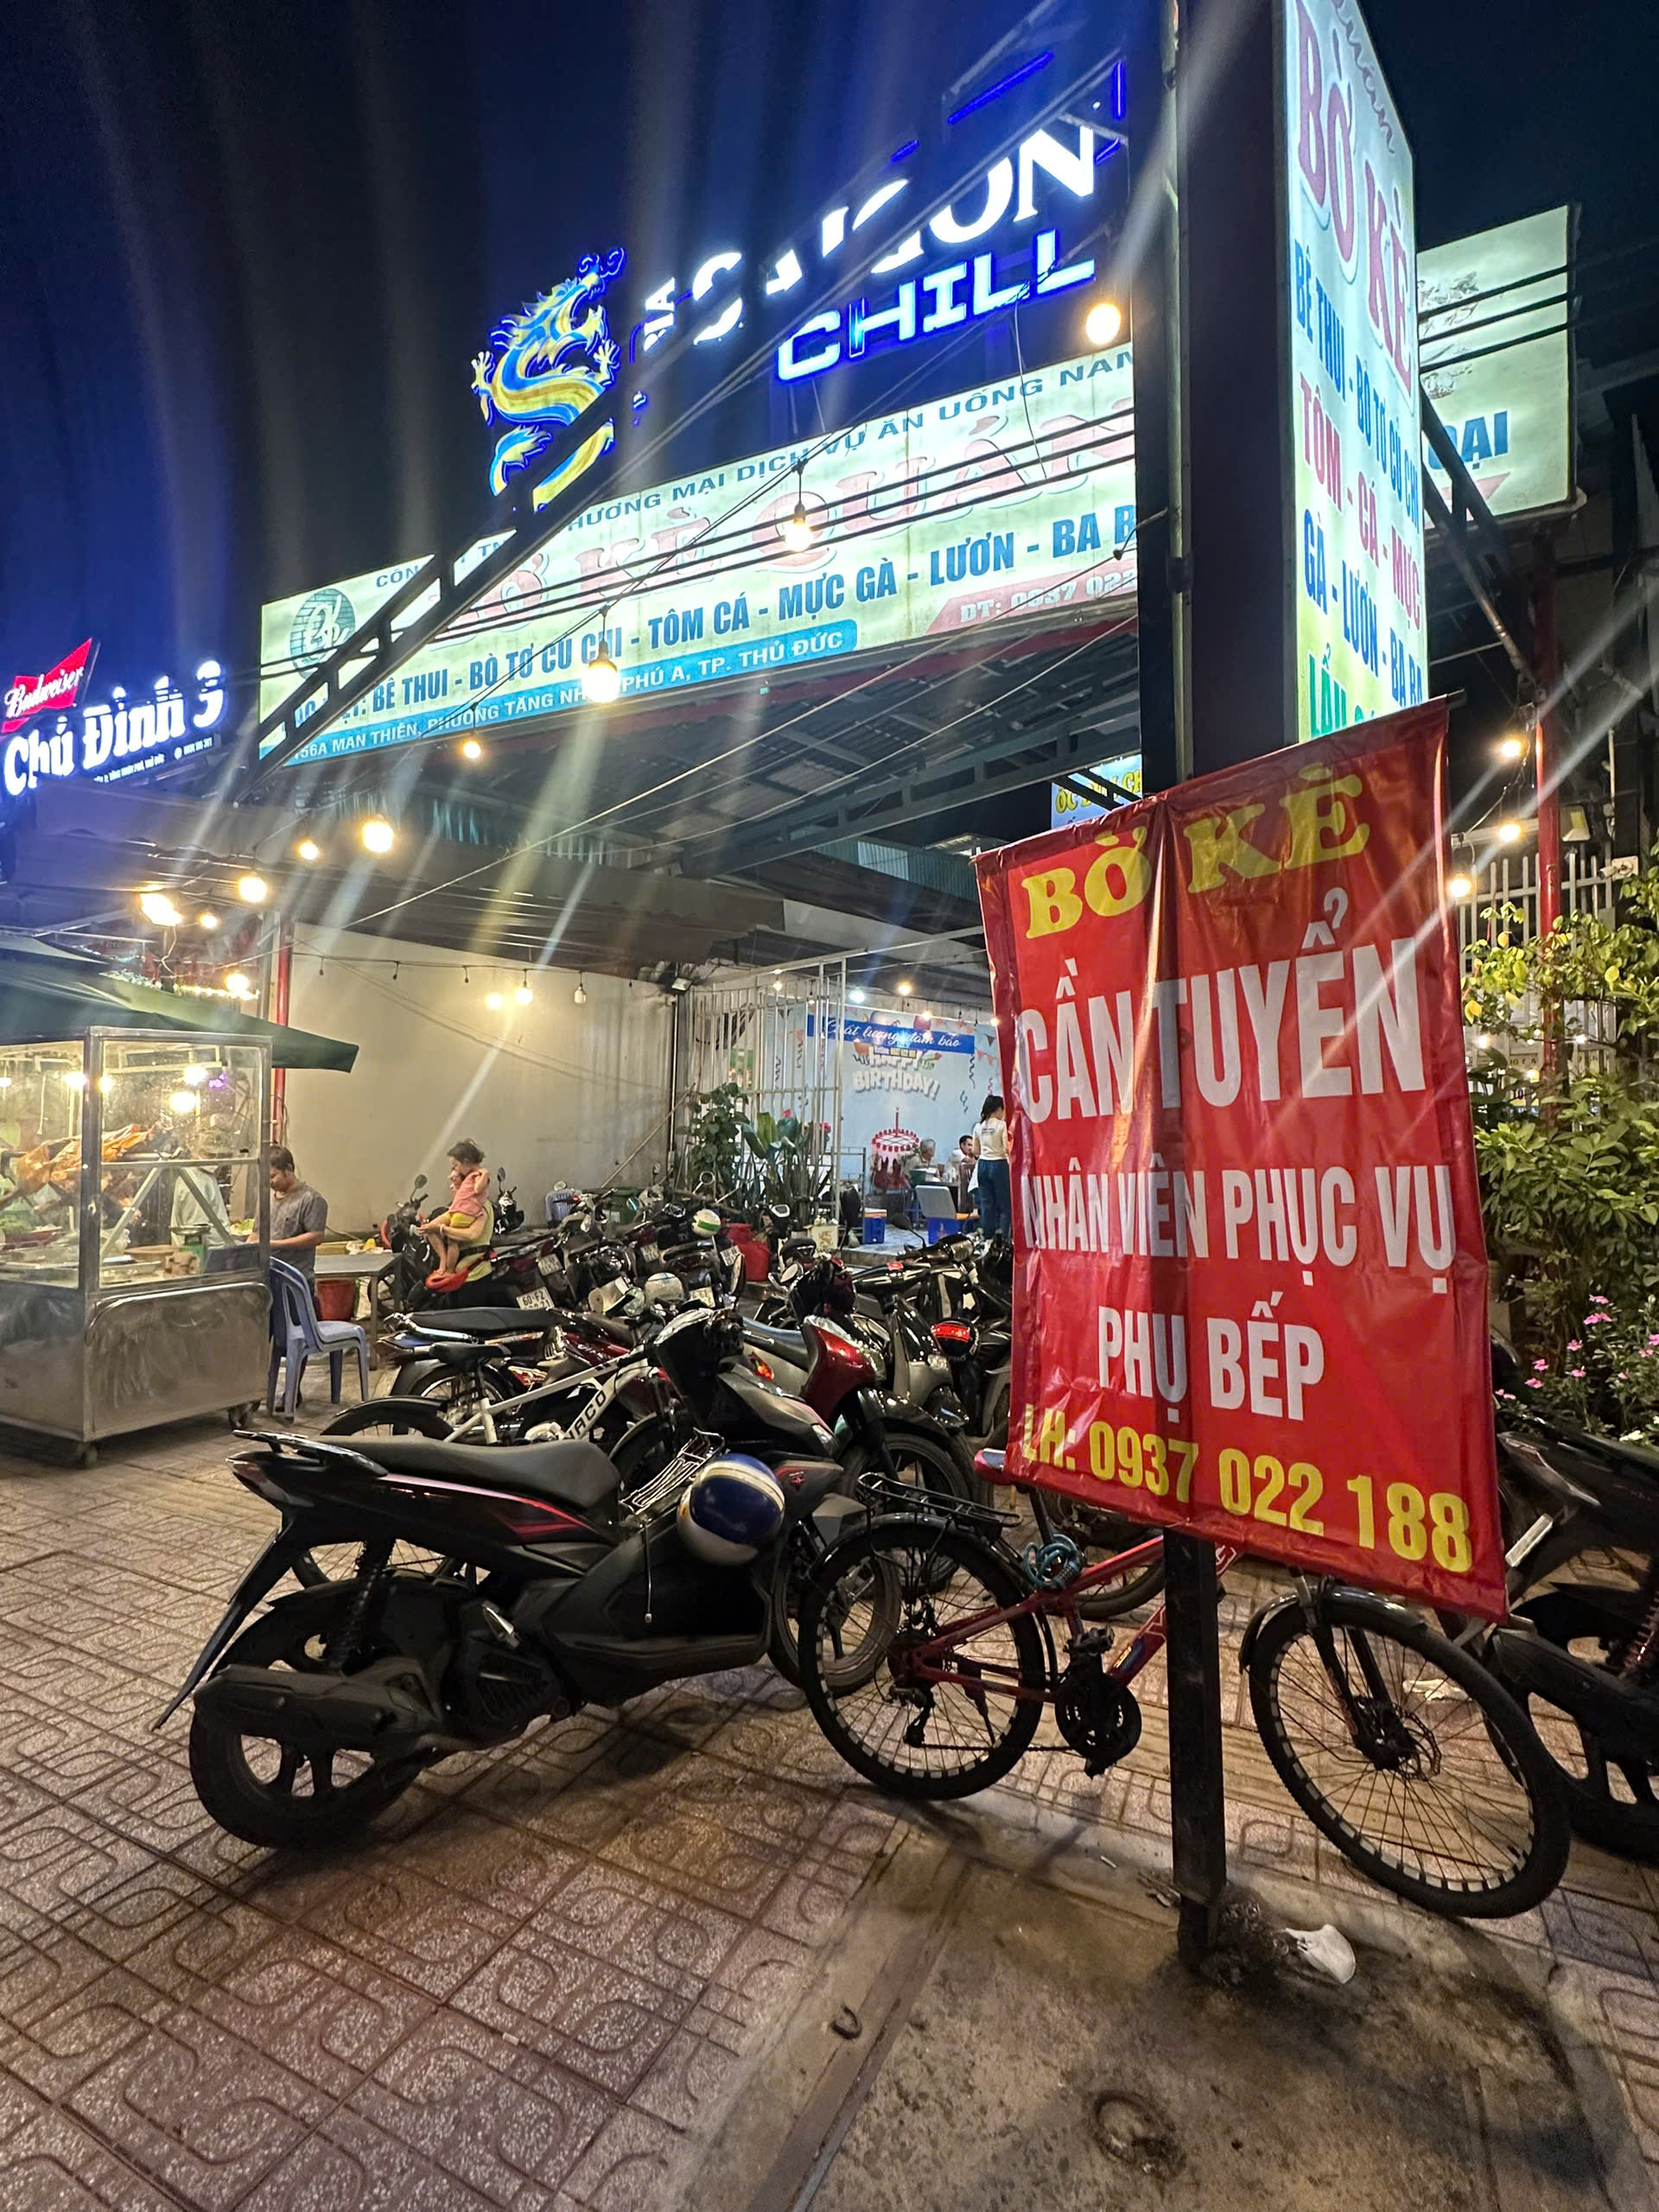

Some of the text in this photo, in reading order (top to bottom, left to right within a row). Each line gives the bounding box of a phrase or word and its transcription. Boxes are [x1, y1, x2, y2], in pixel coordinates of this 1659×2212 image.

[779, 231, 1096, 381] CHILL
[1316, 276, 1346, 403] THUI
[568, 493, 661, 531] HƯƠNG
[672, 474, 724, 501] MẠI
[736, 448, 809, 481] DỊCH
[823, 431, 865, 454] VỤ
[878, 413, 923, 439] ĂN
[939, 378, 1043, 421] UỐNG
[1300, 372, 1421, 631] TÔM CÁ MỰC
[372, 677, 396, 713] BÊ
[402, 669, 448, 705] THUI
[469, 653, 498, 690] BÒ
[505, 643, 534, 682] TƠ
[648, 608, 703, 650] TÔM
[713, 591, 749, 635] CÁ
[779, 573, 844, 620] MỰC
[856, 557, 898, 602] GÀ
[930, 531, 1014, 587] LƯƠN
[1052, 512, 1102, 558] BA
[1115, 504, 1136, 544] B
[1303, 508, 1328, 616] GÀ
[1341, 559, 1378, 678] LƯƠN
[4, 666, 84, 718] Budweiser
[332, 734, 366, 753] MAN
[621, 666, 664, 692] PHÚ
[671, 669, 690, 683] A,
[697, 658, 731, 677] TP.
[739, 639, 785, 669] THỦ
[791, 632, 843, 658] ĐỨC
[1017, 887, 1426, 1123] CẦN TUYỂN
[853, 1069, 940, 1101] BIRTHDAY!
[1020, 1154, 1457, 1294] NHÂN VIÊN PHỤC VỤ
[1098, 1291, 1325, 1423] PHỤ BẾP
[1022, 1403, 1472, 1573] LH: 0937 022 188
